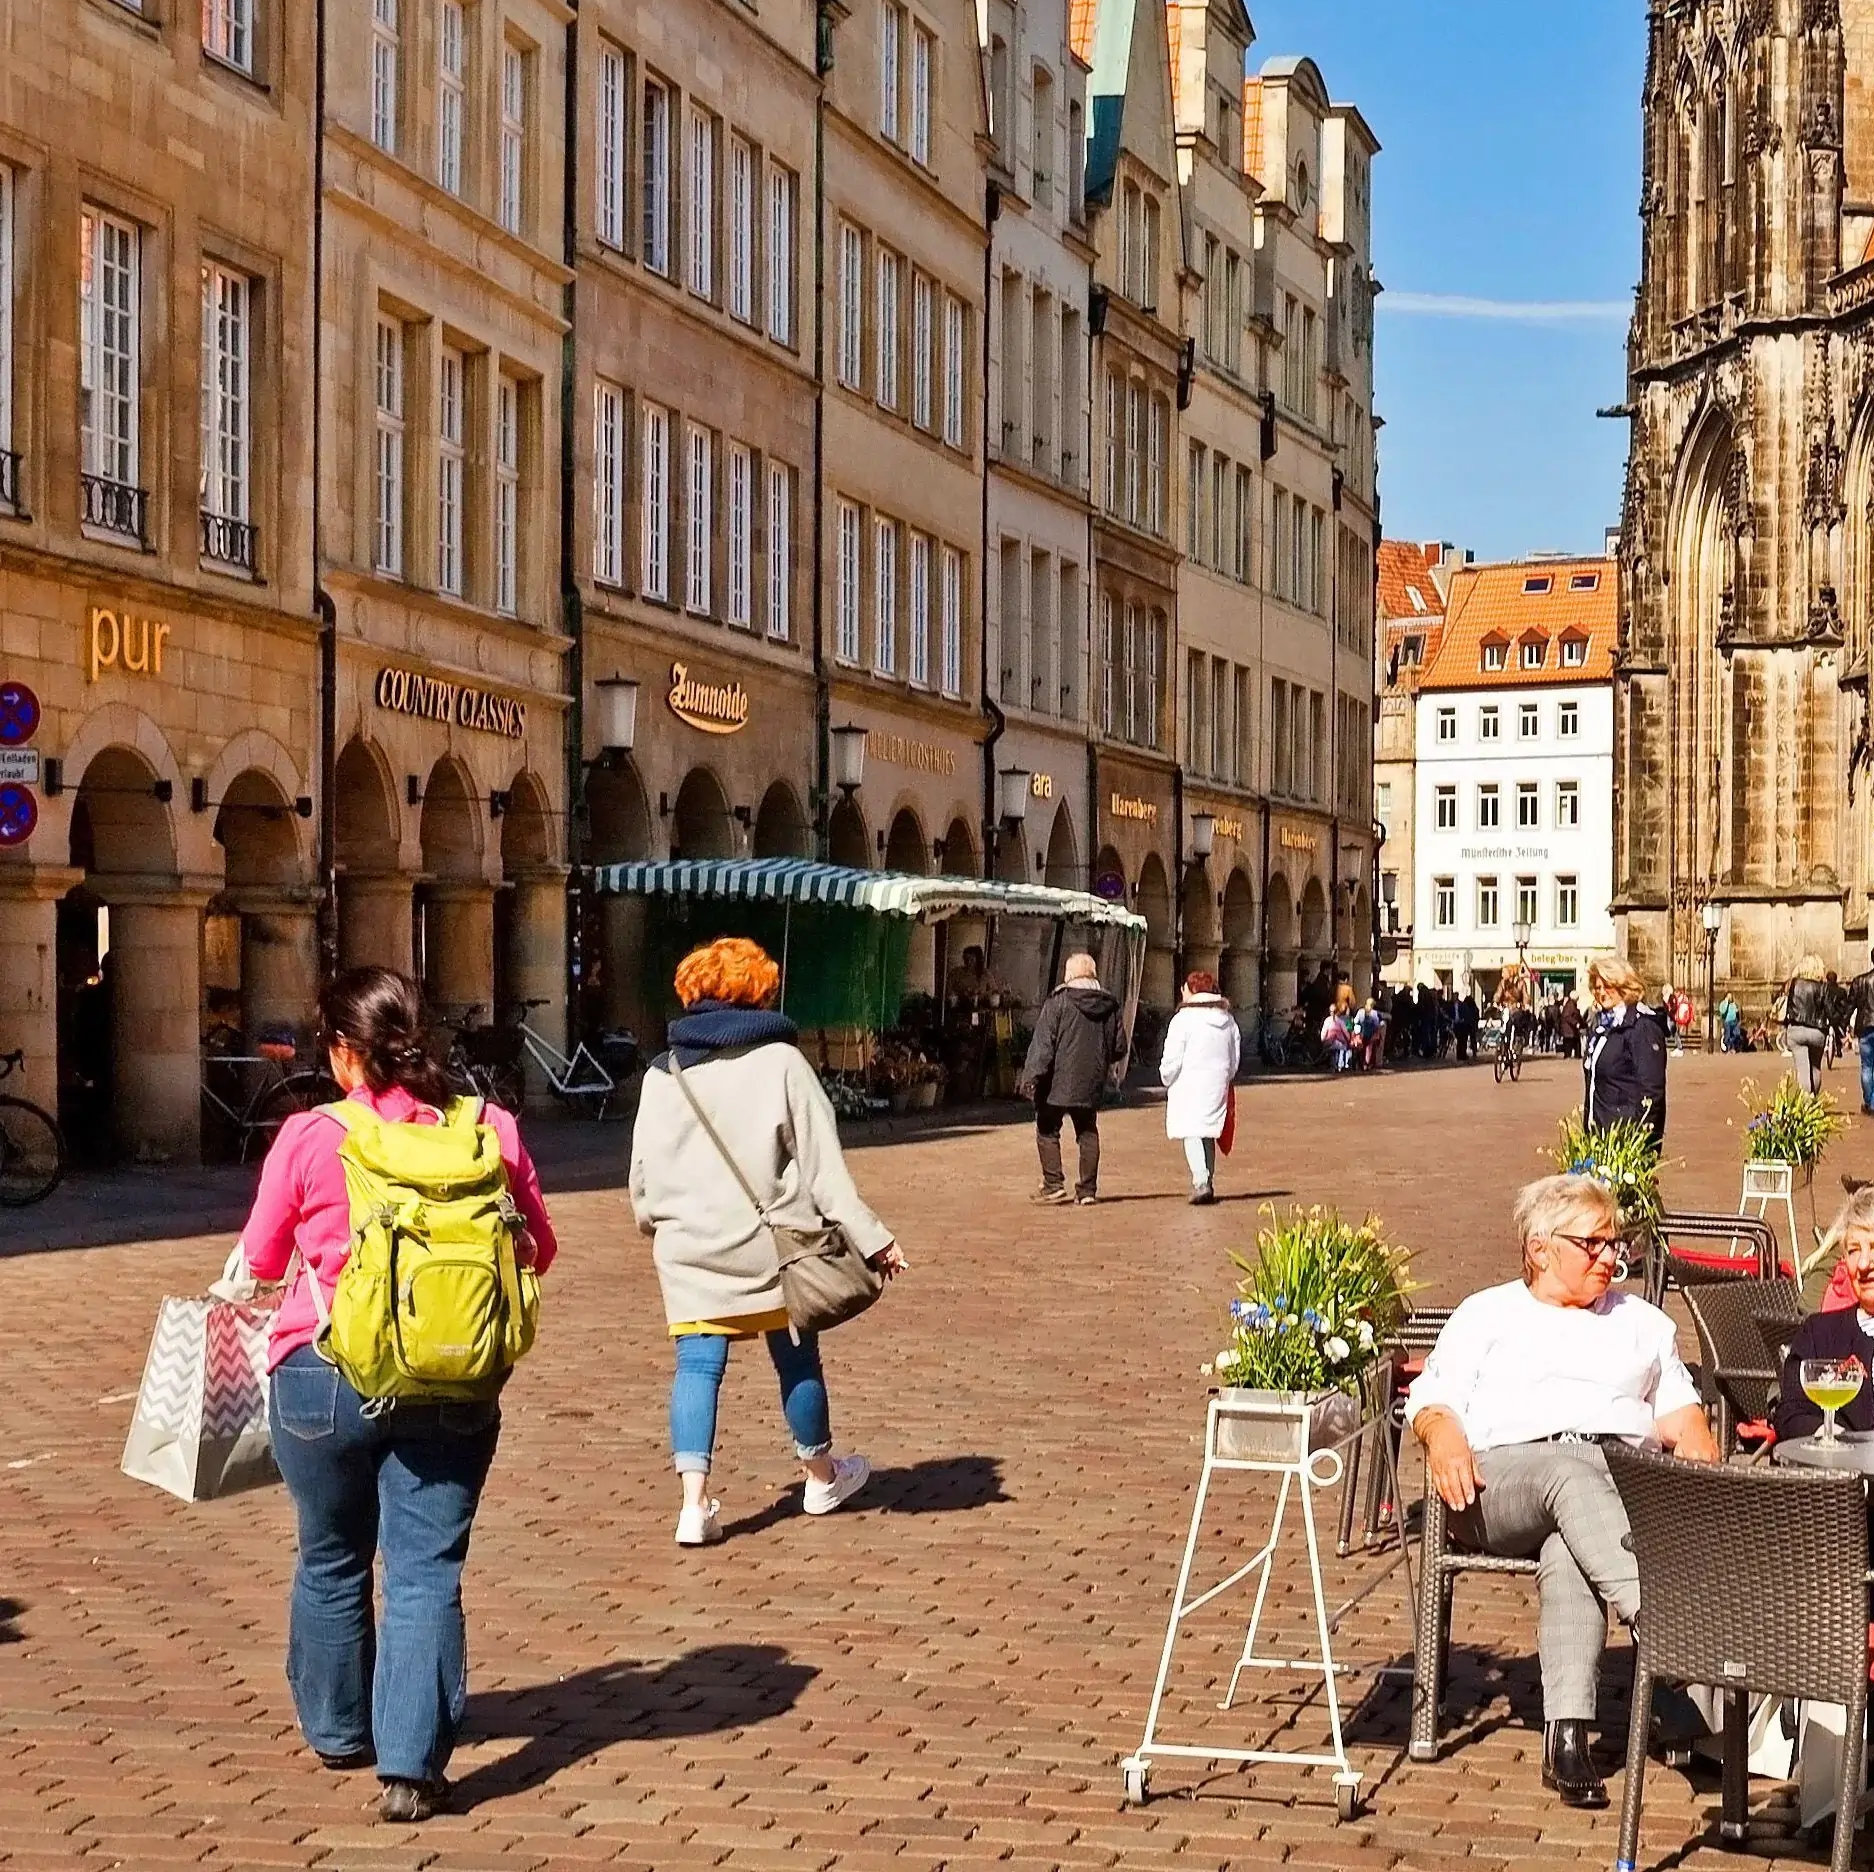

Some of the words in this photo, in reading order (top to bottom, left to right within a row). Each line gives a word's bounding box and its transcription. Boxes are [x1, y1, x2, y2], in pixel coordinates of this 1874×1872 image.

[92, 607, 171, 682] pur
[378, 667, 459, 723] COUNTRY
[459, 687, 528, 738] CLASSICS
[1033, 772, 1053, 798] ara
